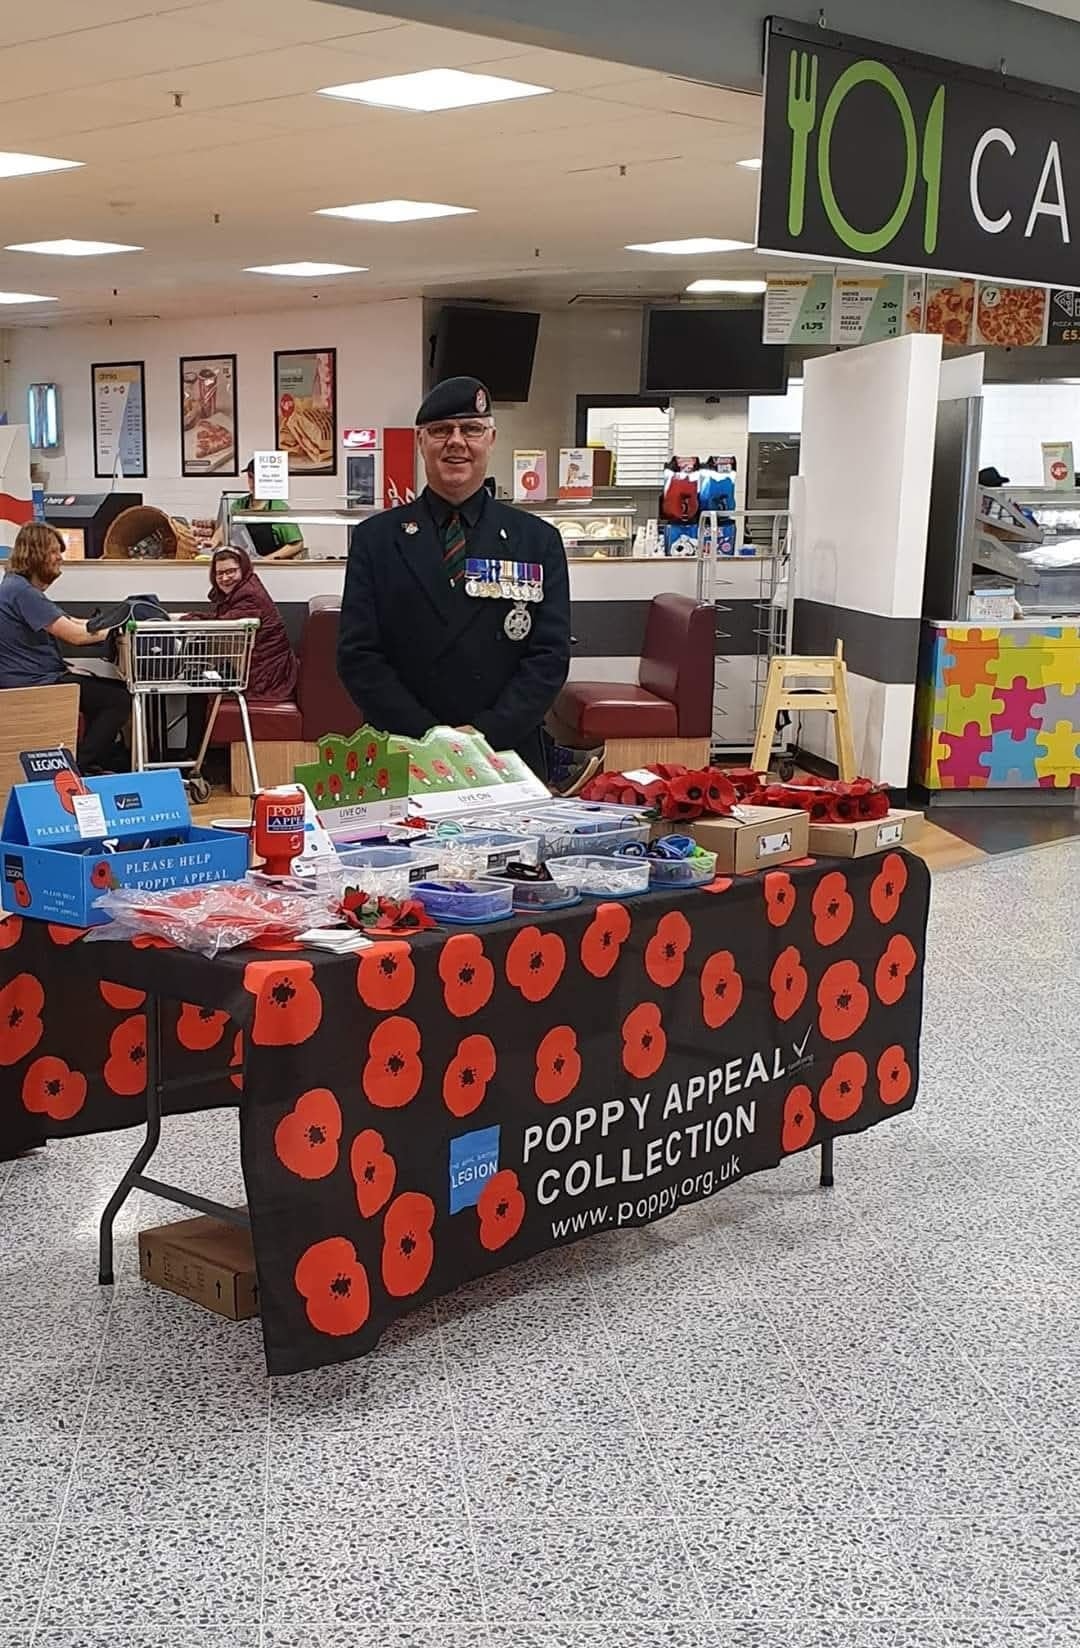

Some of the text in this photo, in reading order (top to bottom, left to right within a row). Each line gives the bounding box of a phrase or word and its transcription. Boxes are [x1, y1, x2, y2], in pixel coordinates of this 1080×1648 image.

[970, 127, 1070, 244] CA
[258, 455, 282, 464] KIDS
[30, 759, 70, 771] LEGION
[149, 811, 182, 823] APPEAL
[339, 806, 368, 818] LIVE ON
[37, 824, 71, 836] PLEASE
[781, 833, 791, 848] A
[126, 852, 212, 874] PLEASE HELP
[137, 875, 178, 891] POPPY
[182, 868, 230, 885] APPEAL
[522, 1047, 786, 1163] POPPY APPEAL
[536, 1101, 757, 1205] COLLECTION
[451, 1159, 499, 1188] LEGION
